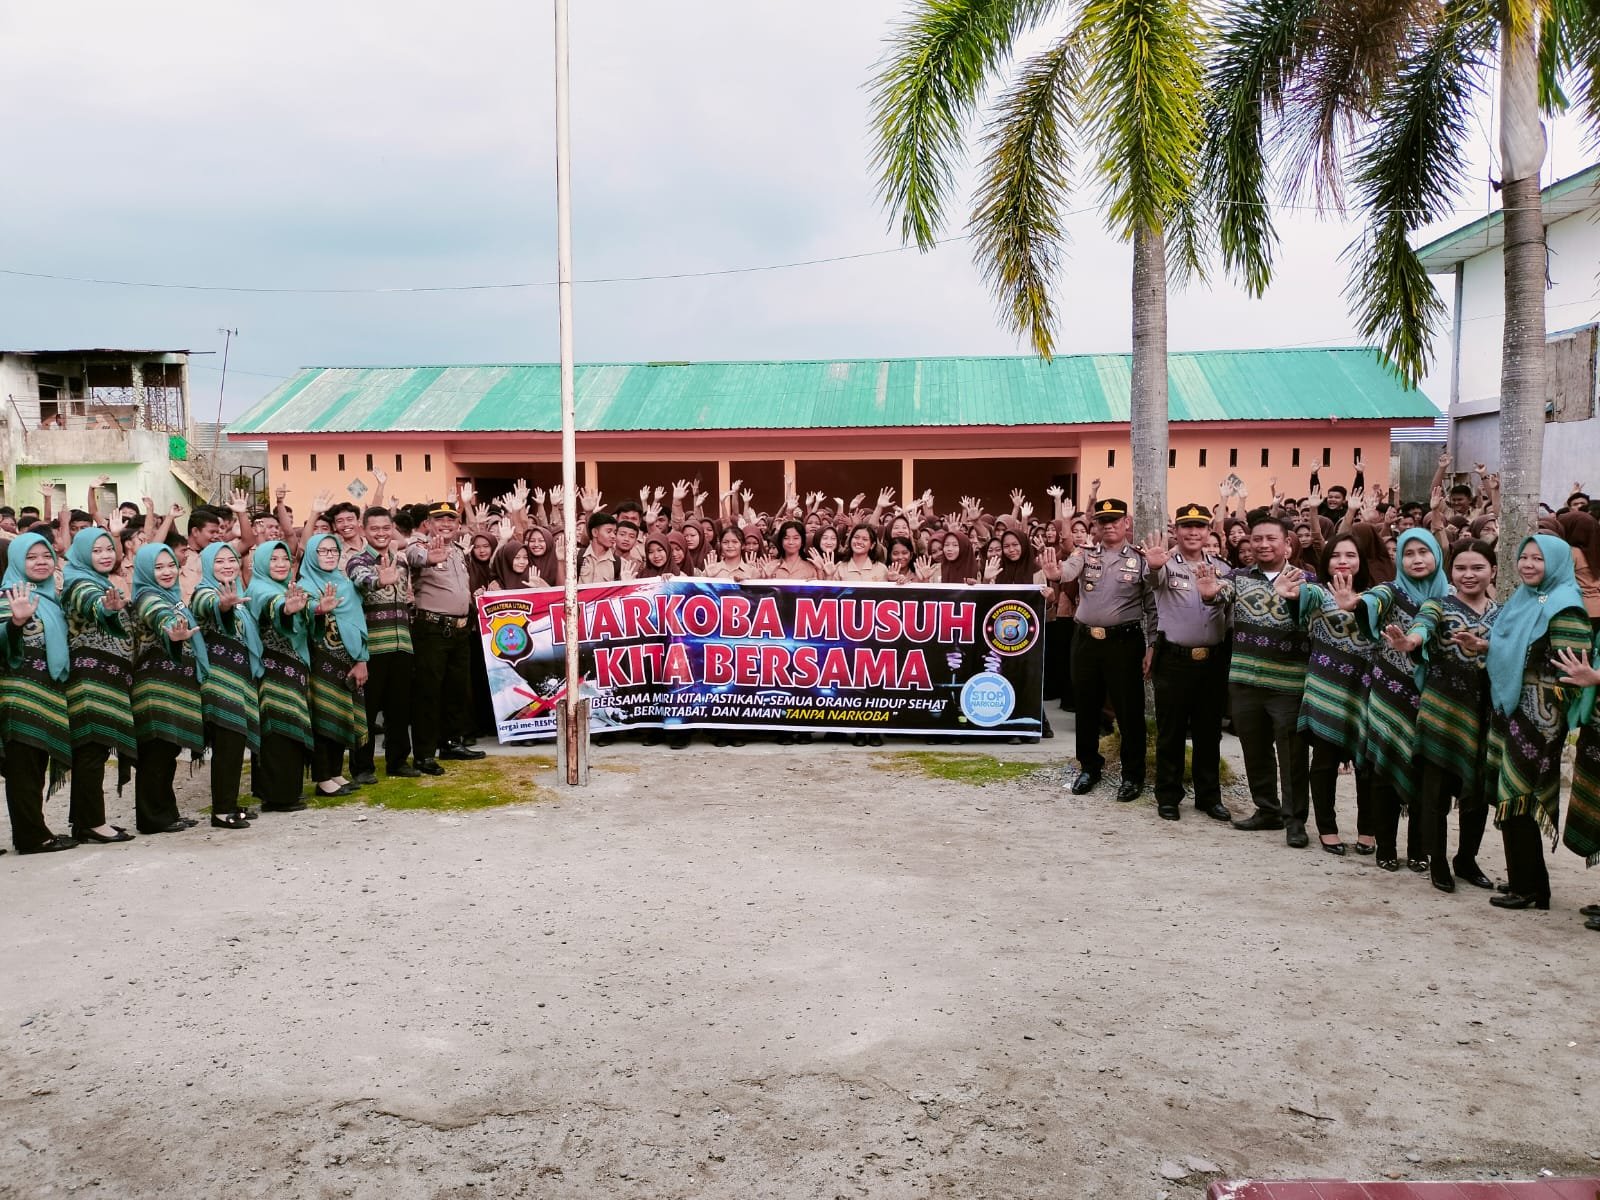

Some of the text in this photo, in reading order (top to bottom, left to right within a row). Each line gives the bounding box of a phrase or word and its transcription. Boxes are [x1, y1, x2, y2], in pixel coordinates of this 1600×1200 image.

[549, 595, 976, 645] NARKOBA MUSUH
[594, 643, 933, 691] KITA BERSAMA
[592, 693, 650, 708] BERSAMA
[676, 693, 701, 704] KITA
[769, 695, 812, 707] SEMUA
[815, 696, 862, 708] ORANG
[864, 698, 906, 709] HIDUP
[908, 699, 949, 710] SEHAT
[972, 691, 1004, 701] STOP
[712, 706, 740, 717] DAN
[742, 707, 781, 719] AMAN
[785, 708, 825, 720] TANPA
[827, 710, 890, 721] NARKOBA
